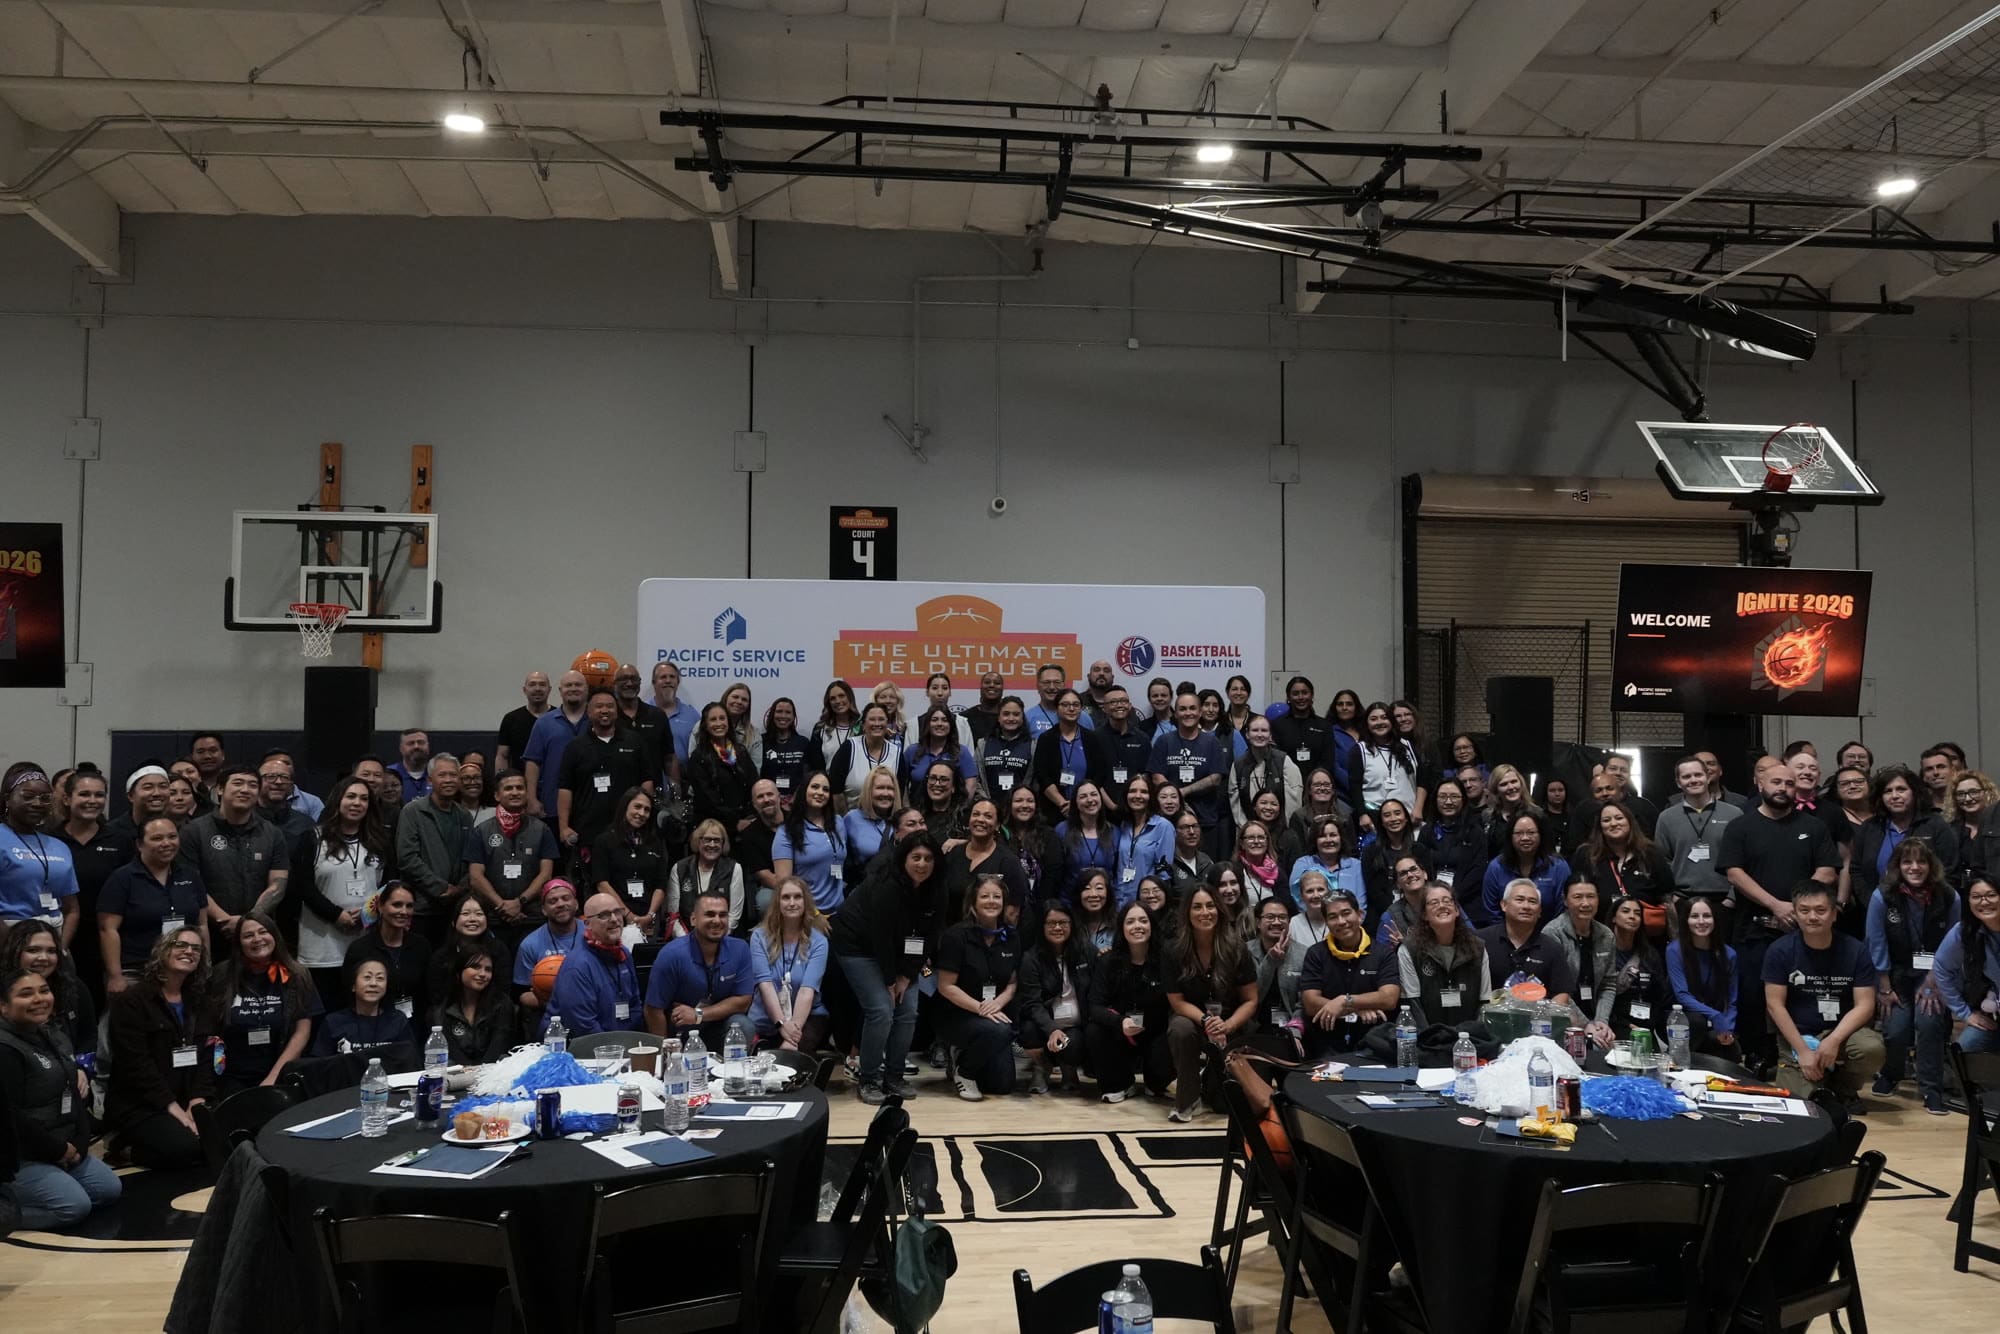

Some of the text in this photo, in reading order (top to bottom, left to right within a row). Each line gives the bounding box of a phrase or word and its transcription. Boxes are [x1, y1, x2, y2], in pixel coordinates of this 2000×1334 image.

[852, 530, 876, 539] COURT
[0, 551, 42, 576] 026
[853, 541, 874, 577] 4
[1737, 592, 1855, 618] IGNITE 2026
[1630, 613, 1711, 628] WELCOME
[657, 649, 725, 662] PACIFIC
[732, 650, 806, 662] SERVICE
[849, 643, 1066, 660] THE ULTIMATE
[1160, 645, 1241, 657] BASKETBALL
[860, 661, 1038, 676] FIELDHOUS
[1203, 660, 1242, 668] NATION
[679, 667, 730, 678] CREDIT
[734, 667, 780, 678] UNION
